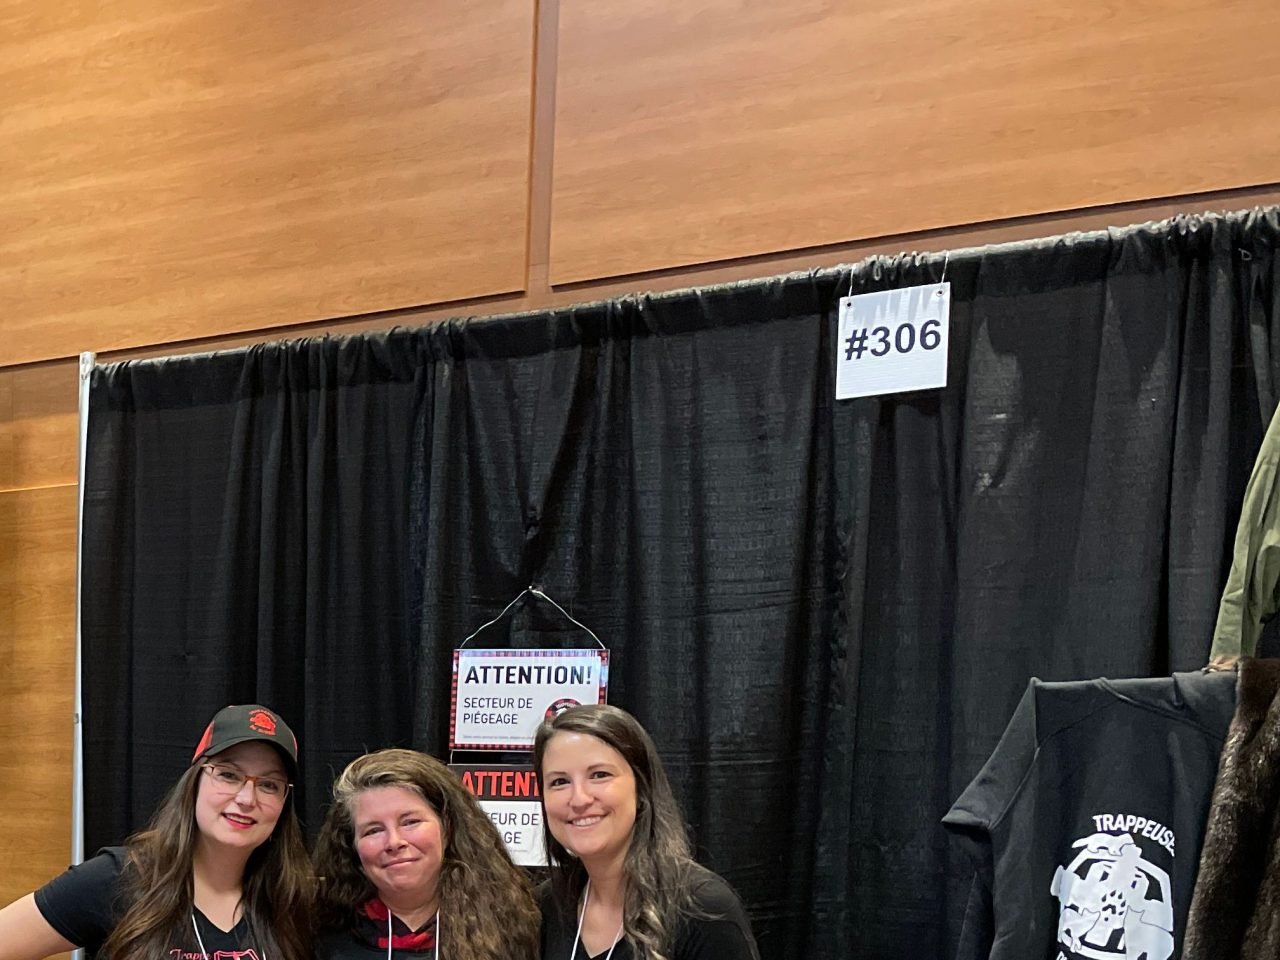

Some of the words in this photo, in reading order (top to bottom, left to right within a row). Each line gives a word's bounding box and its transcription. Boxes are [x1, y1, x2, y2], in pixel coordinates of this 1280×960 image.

[845, 319, 941, 360] #306
[464, 665, 592, 685] ATTENTION!
[463, 697, 515, 709] SECTEUR
[517, 698, 534, 709] DE
[463, 711, 519, 725] PIÉGEAGE
[521, 813, 540, 826] DE
